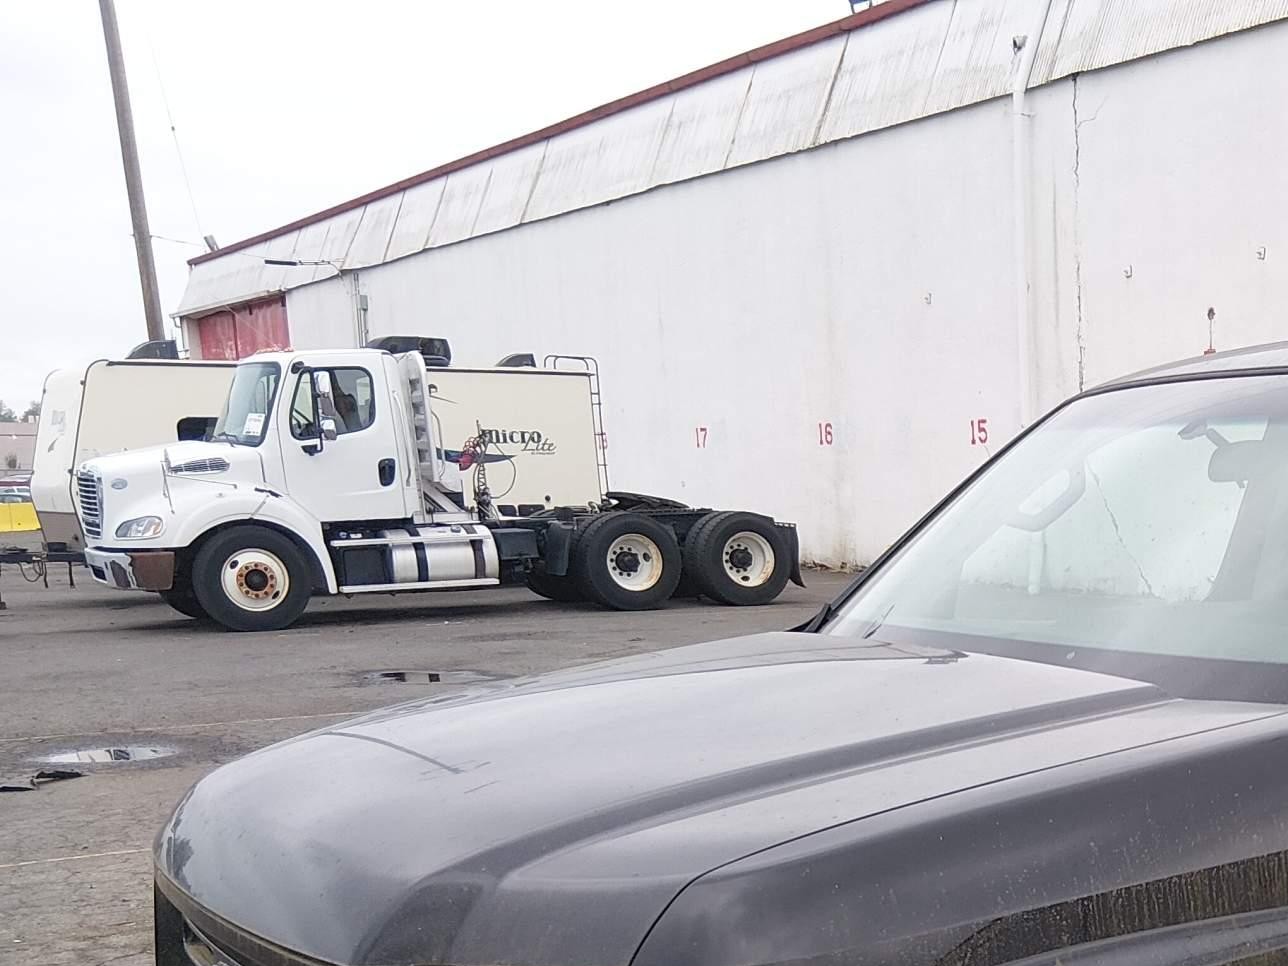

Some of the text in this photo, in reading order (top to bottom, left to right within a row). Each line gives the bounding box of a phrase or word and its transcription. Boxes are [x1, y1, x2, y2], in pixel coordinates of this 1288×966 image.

[695, 427, 708, 448] 17
[818, 423, 833, 445] 16
[970, 419, 988, 445] 15
[521, 434, 557, 452] Lite
